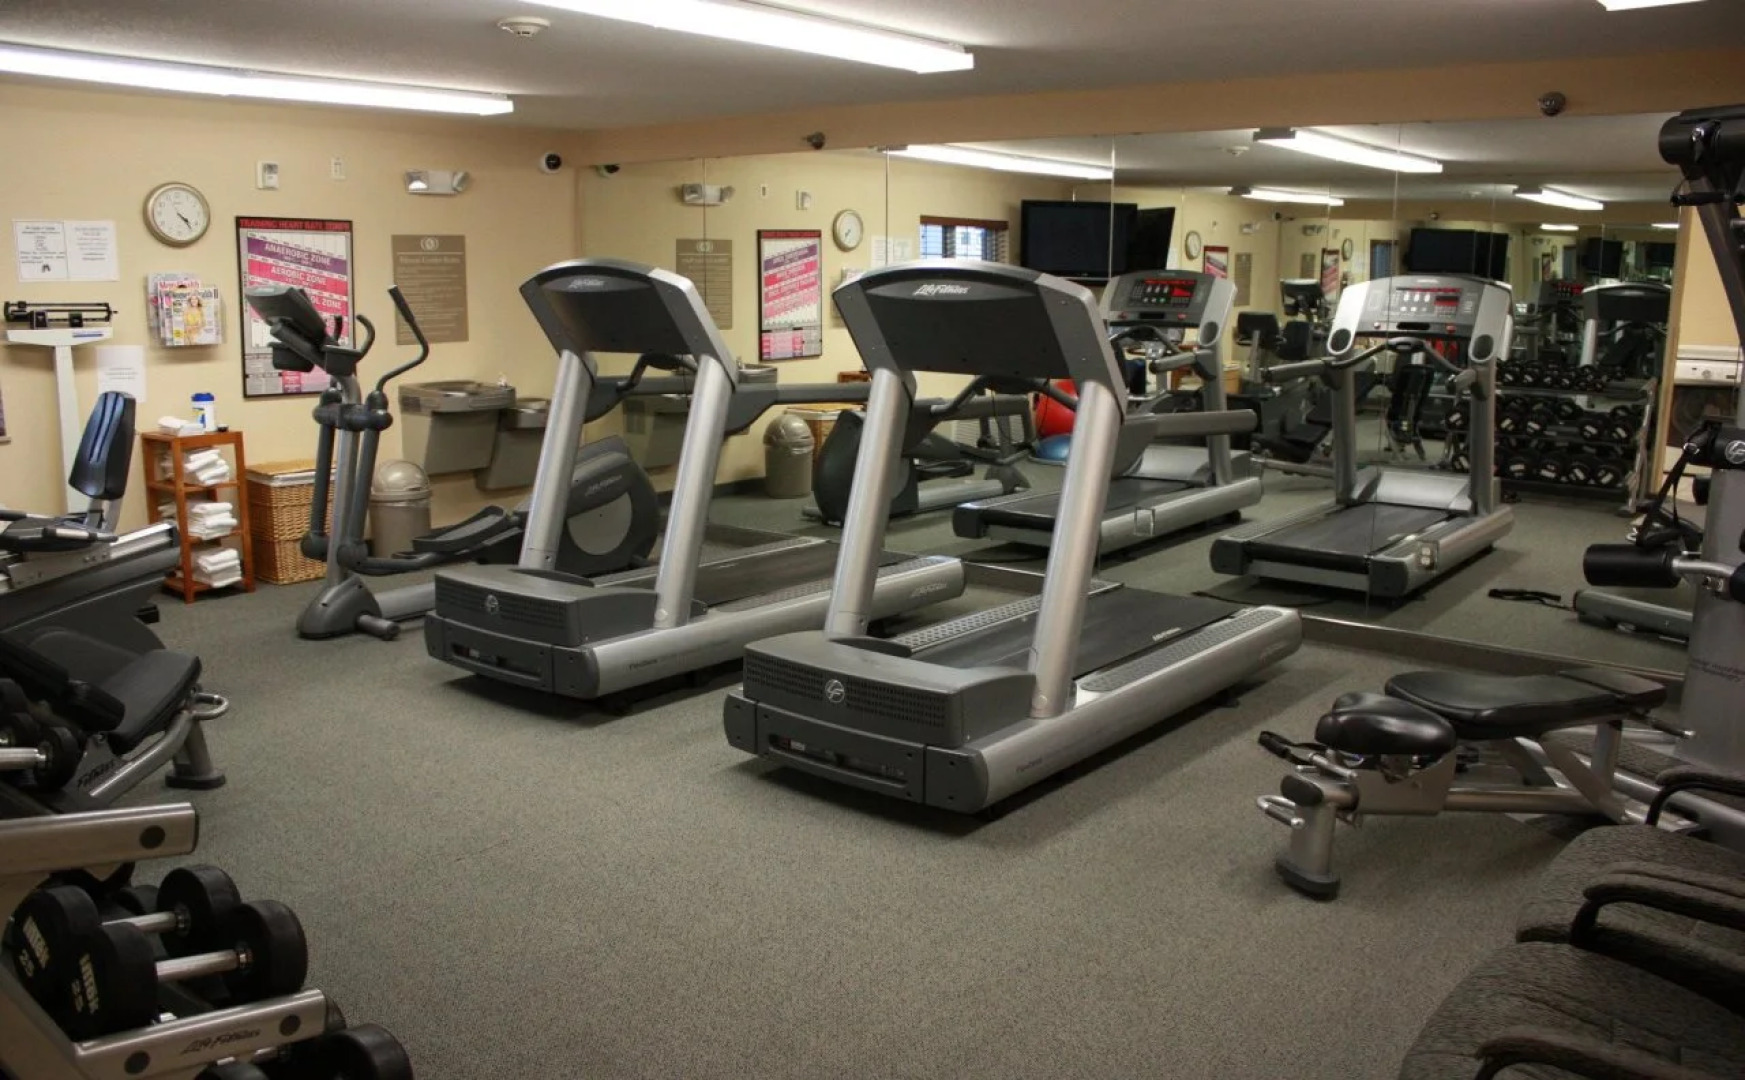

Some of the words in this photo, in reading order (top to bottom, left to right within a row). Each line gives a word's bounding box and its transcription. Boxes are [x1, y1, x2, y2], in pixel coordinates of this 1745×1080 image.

[279, 220, 303, 230] HEART
[264, 243, 309, 260] ANAEROBIC
[311, 254, 331, 265] ZONE
[270, 266, 305, 280] AEROBIC
[306, 273, 327, 285] ZONE
[321, 298, 342, 309] ZONE
